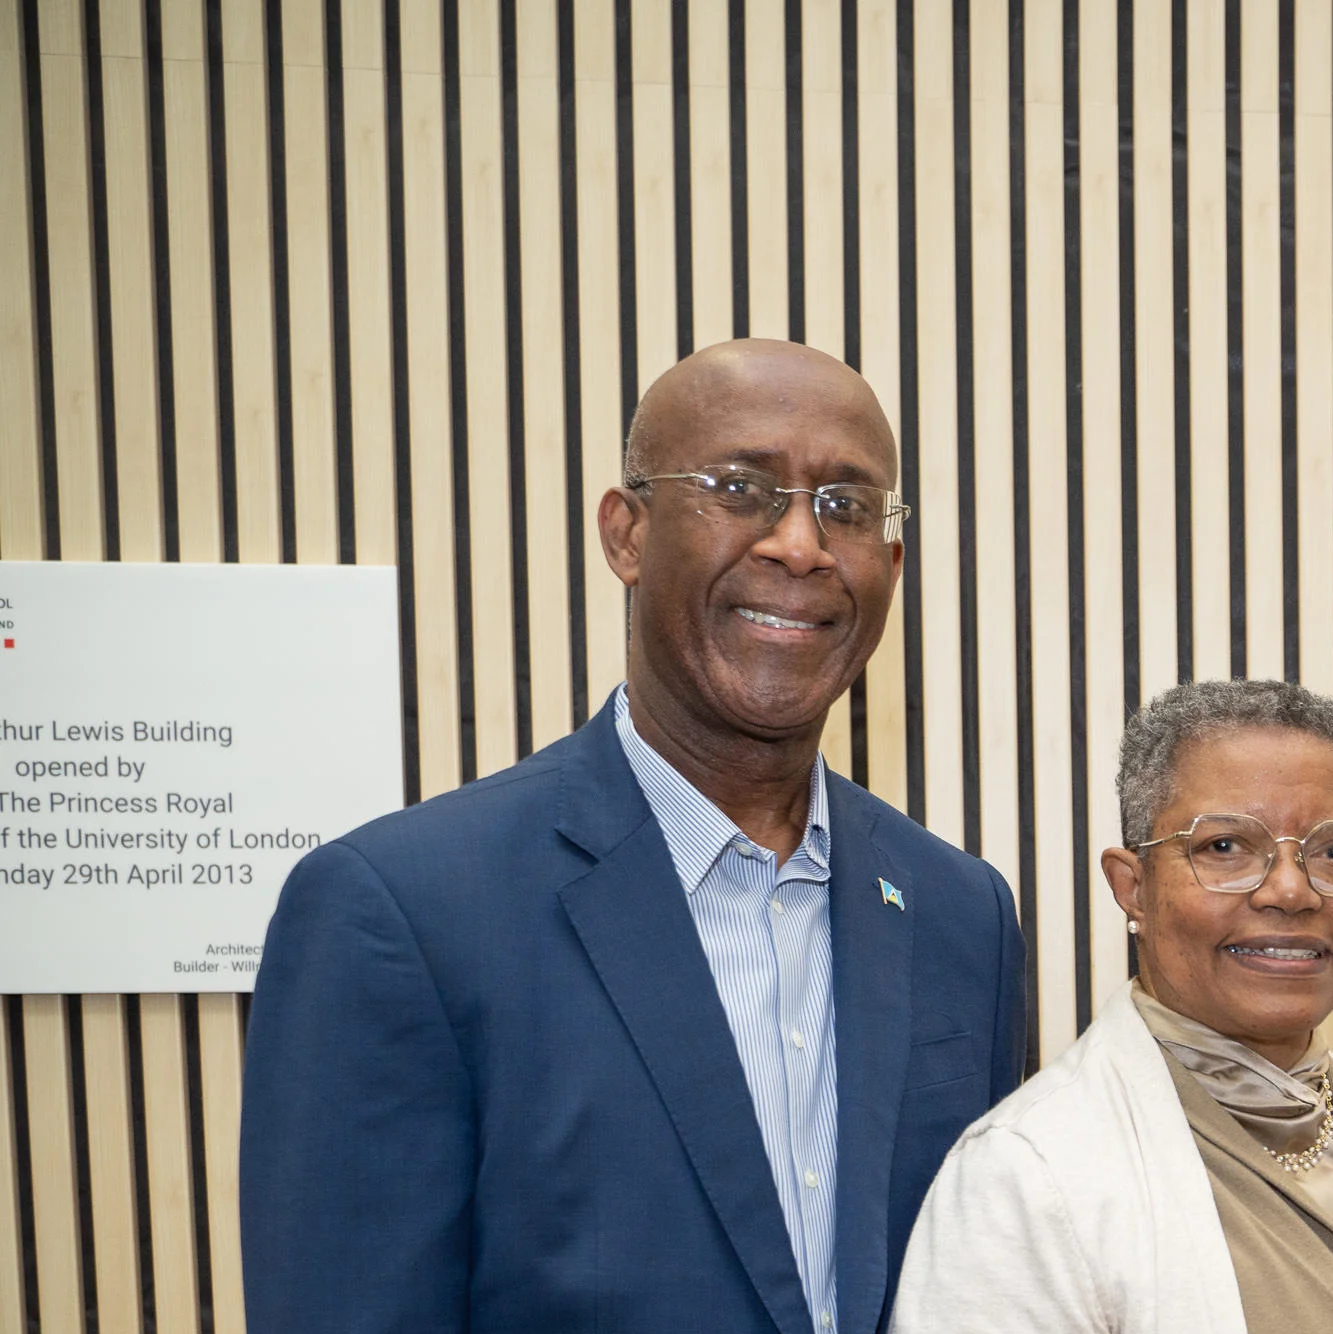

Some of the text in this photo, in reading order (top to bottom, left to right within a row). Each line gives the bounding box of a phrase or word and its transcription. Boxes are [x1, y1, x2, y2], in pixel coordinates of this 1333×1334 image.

[0, 619, 14, 629] ND
[0, 718, 232, 747] hur Lewis Building
[15, 755, 145, 782] opened by
[0, 791, 232, 818] The Princess Royal
[16, 827, 57, 848] the
[66, 828, 187, 854] University
[196, 827, 220, 848] of
[229, 827, 321, 849] London
[0, 862, 252, 890] nday 29th April 2013
[173, 960, 219, 973] Builder
[231, 960, 260, 972] Will
